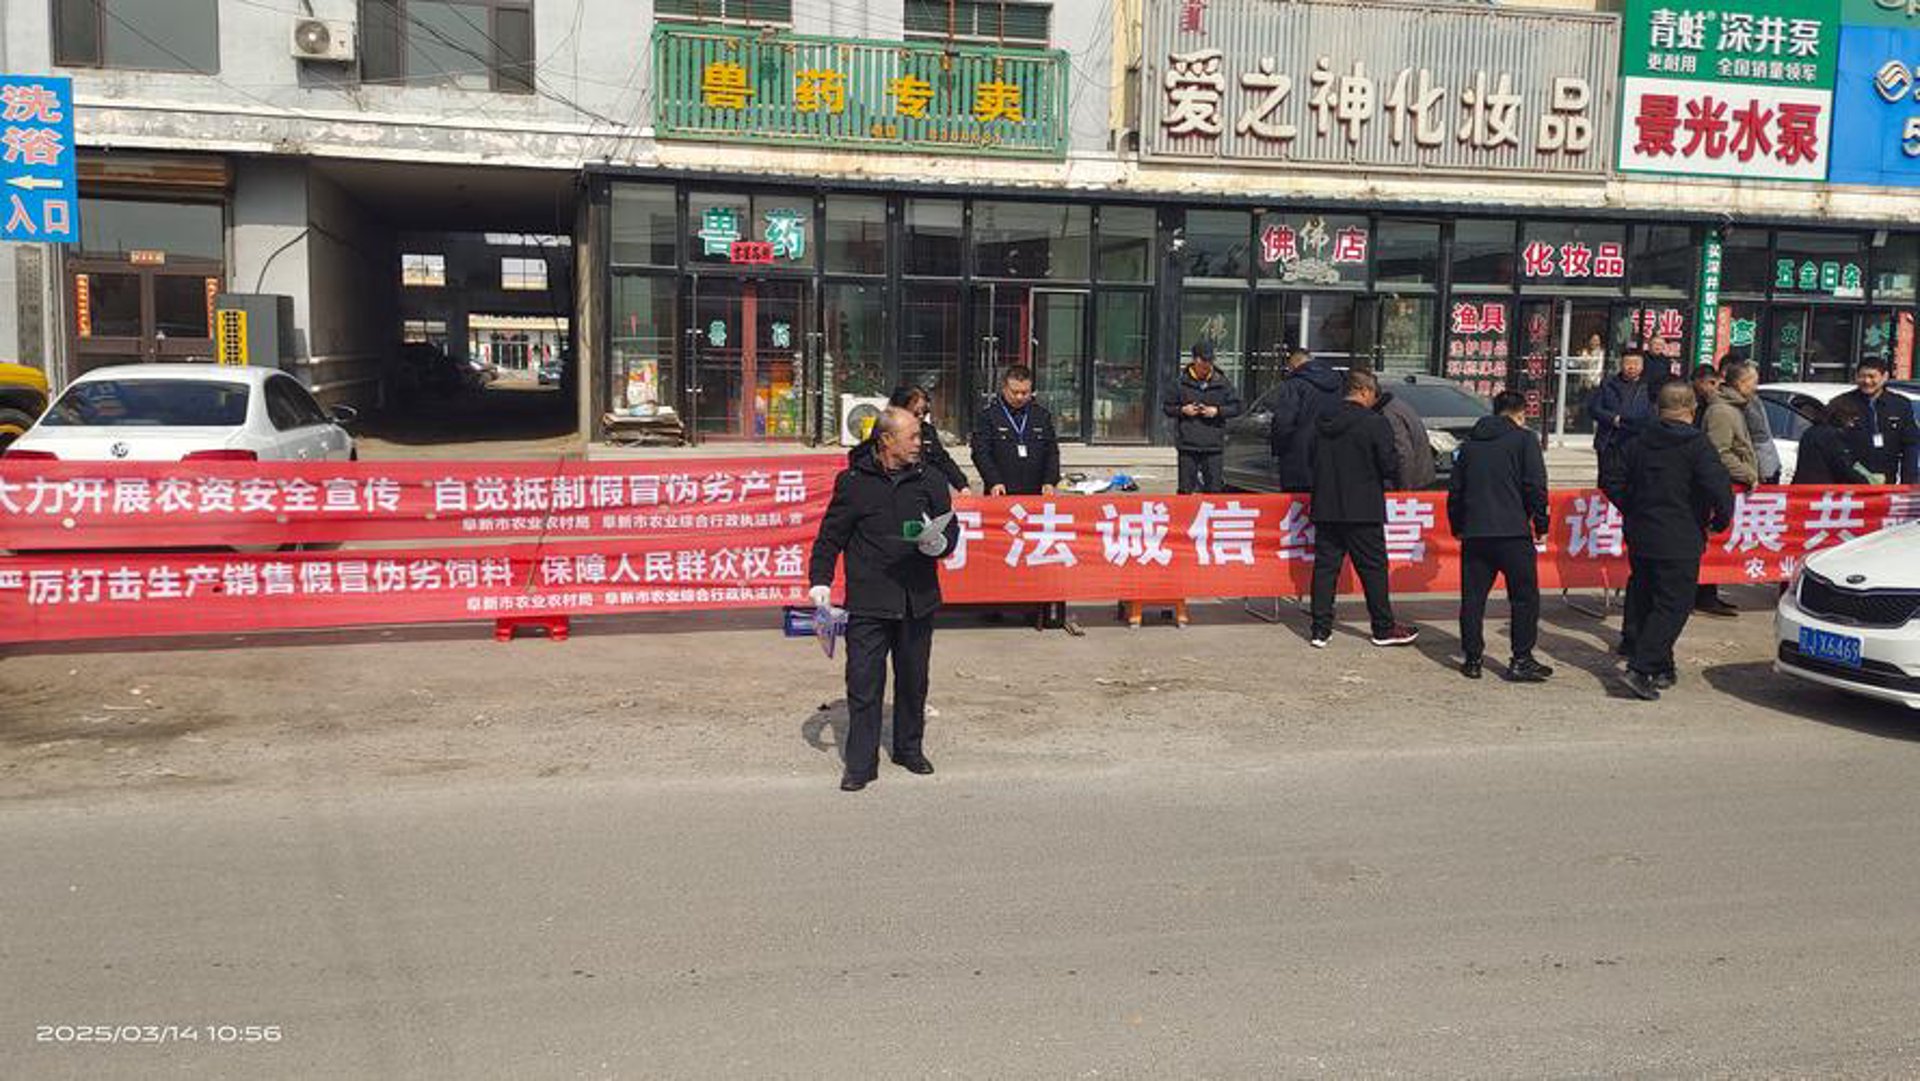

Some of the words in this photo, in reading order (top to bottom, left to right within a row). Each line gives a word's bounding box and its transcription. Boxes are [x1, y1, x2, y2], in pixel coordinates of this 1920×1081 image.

[1716, 12, 1822, 57] 深井泵
[1647, 53, 1697, 73] 更耐用
[1715, 58, 1818, 82] 全国销量领军
[700, 61, 1024, 123] 兽药专卖
[1160, 48, 1595, 154] 爱之神化妆品
[0, 84, 66, 166] 洗浴
[1633, 93, 1822, 165] 景光水泵
[5, 193, 71, 235] 入口
[698, 207, 807, 260] 兽药
[1523, 241, 1625, 278] 化妆品
[1775, 258, 1862, 292] 五金日杂
[1450, 302, 1506, 334] 渔具
[434, 470, 808, 512] 自觉抵制假冒伪劣产品
[462, 516, 591, 532] 阜新市农业农村局
[602, 513, 784, 530] 阜新市农业综合行政执法队
[540, 544, 804, 585] 保障人民群众权益
[466, 594, 594, 611] 阜新市农业农村局
[604, 587, 784, 605] 阜新市农业综合行政执法队
